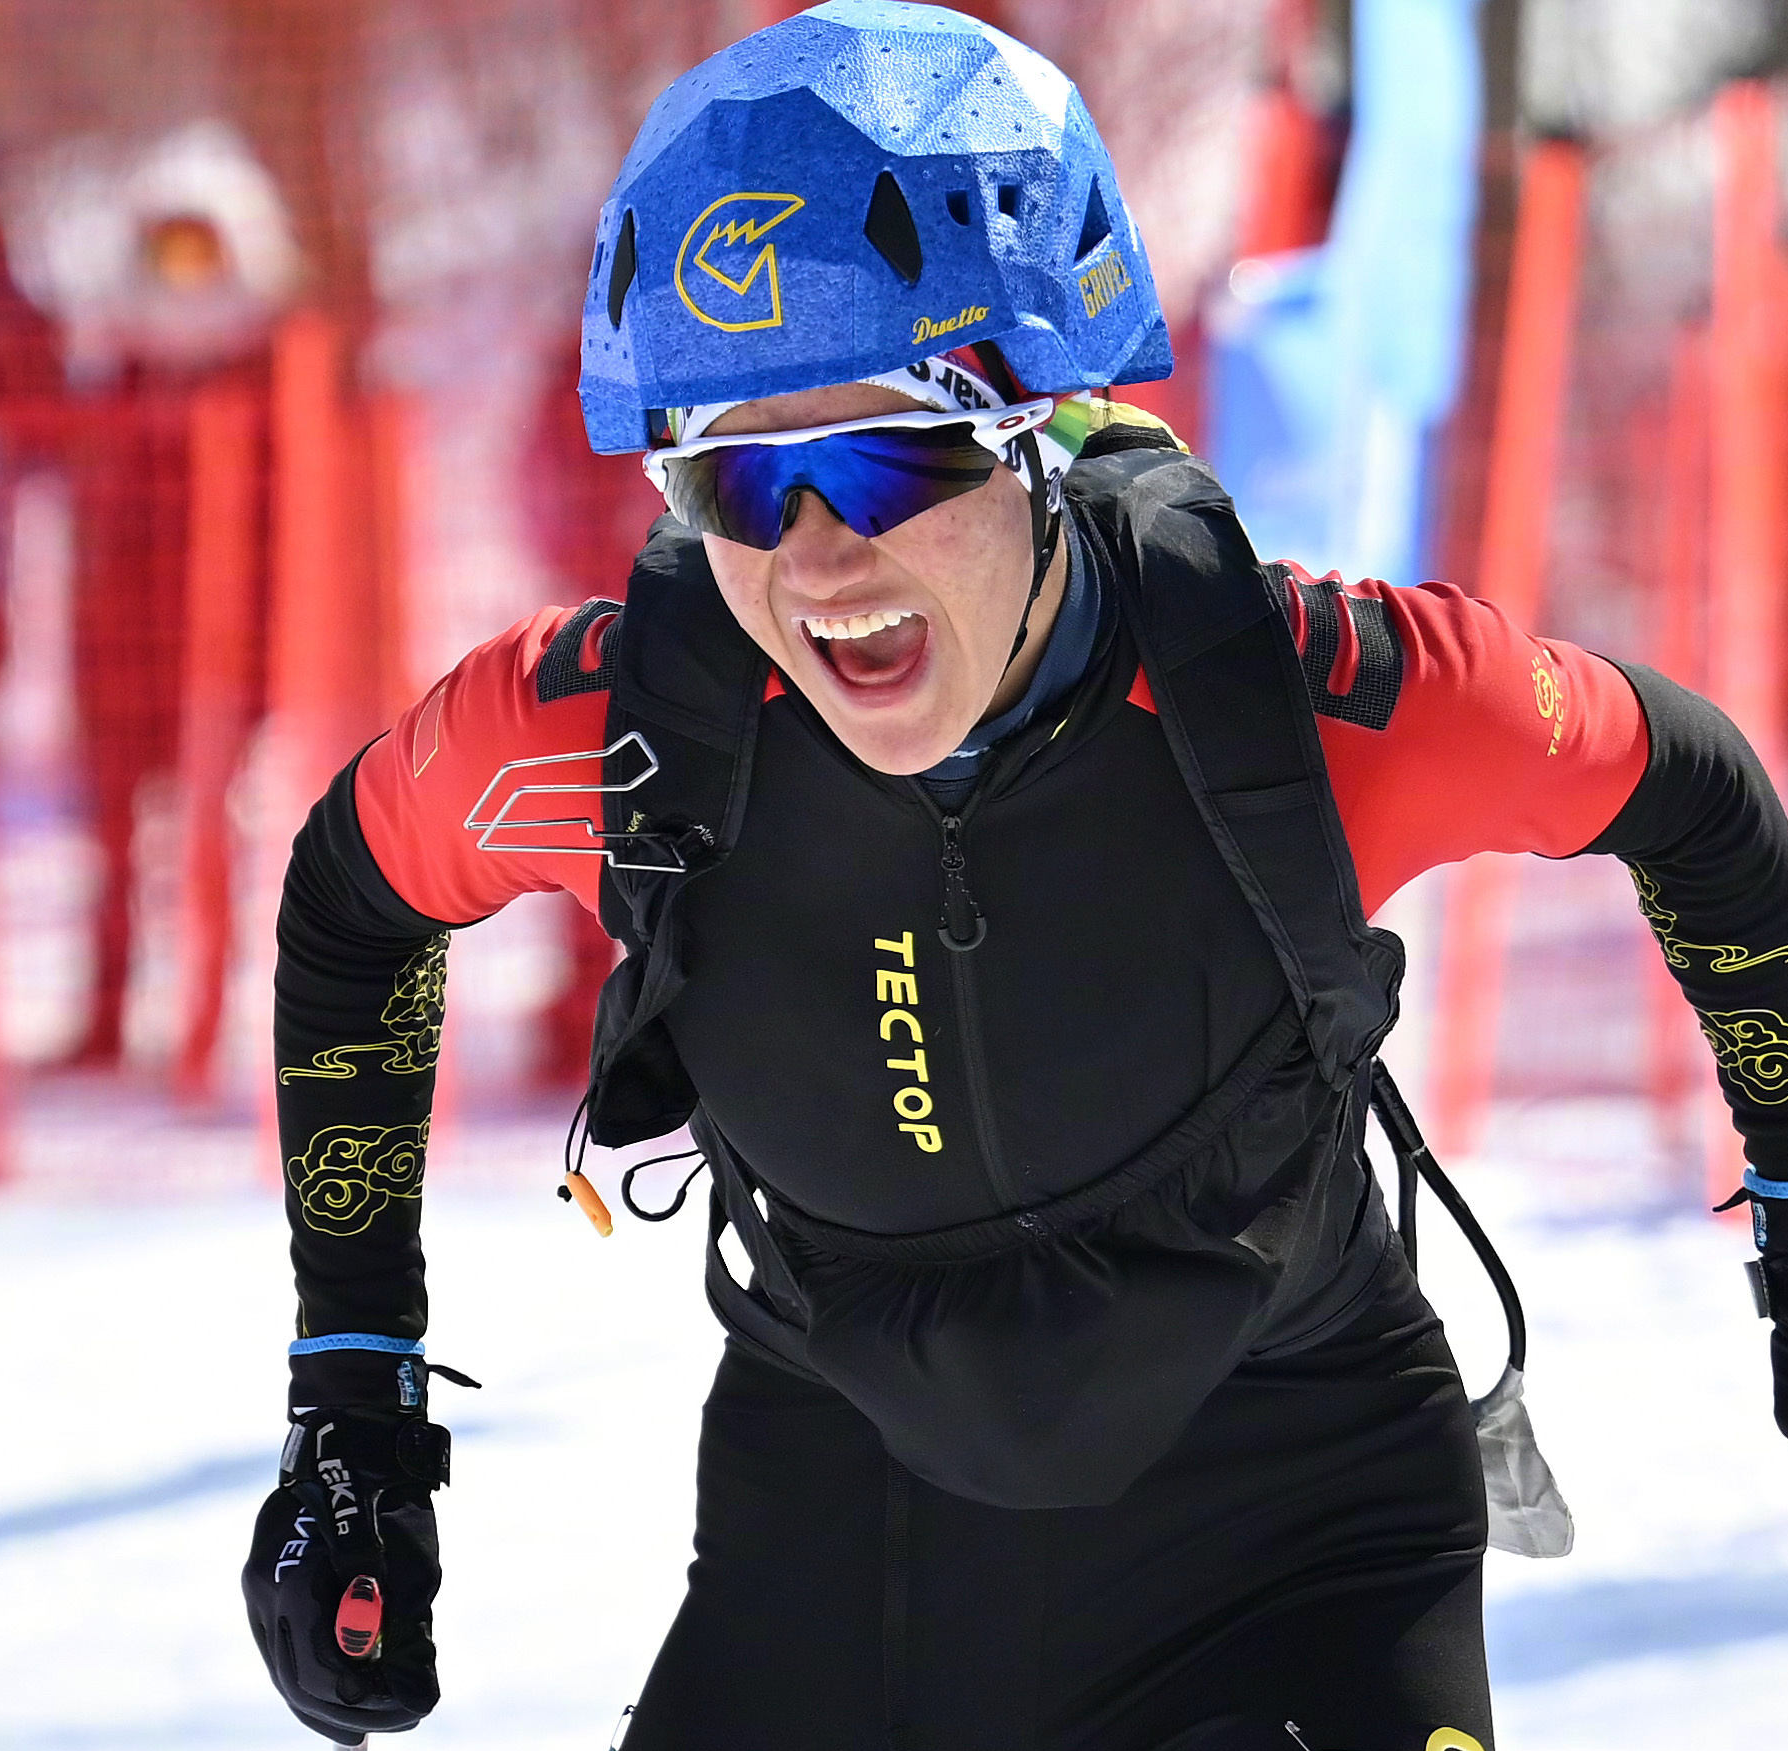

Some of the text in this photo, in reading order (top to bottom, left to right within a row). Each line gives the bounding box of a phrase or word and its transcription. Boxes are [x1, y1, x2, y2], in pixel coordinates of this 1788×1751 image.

[1079, 250, 1132, 319] GRIVEL
[912, 305, 990, 345] Duetto
[874, 931, 943, 1153] TECTOP
[316, 1422, 359, 1519] LEKI
[275, 1506, 316, 1583] VEL
